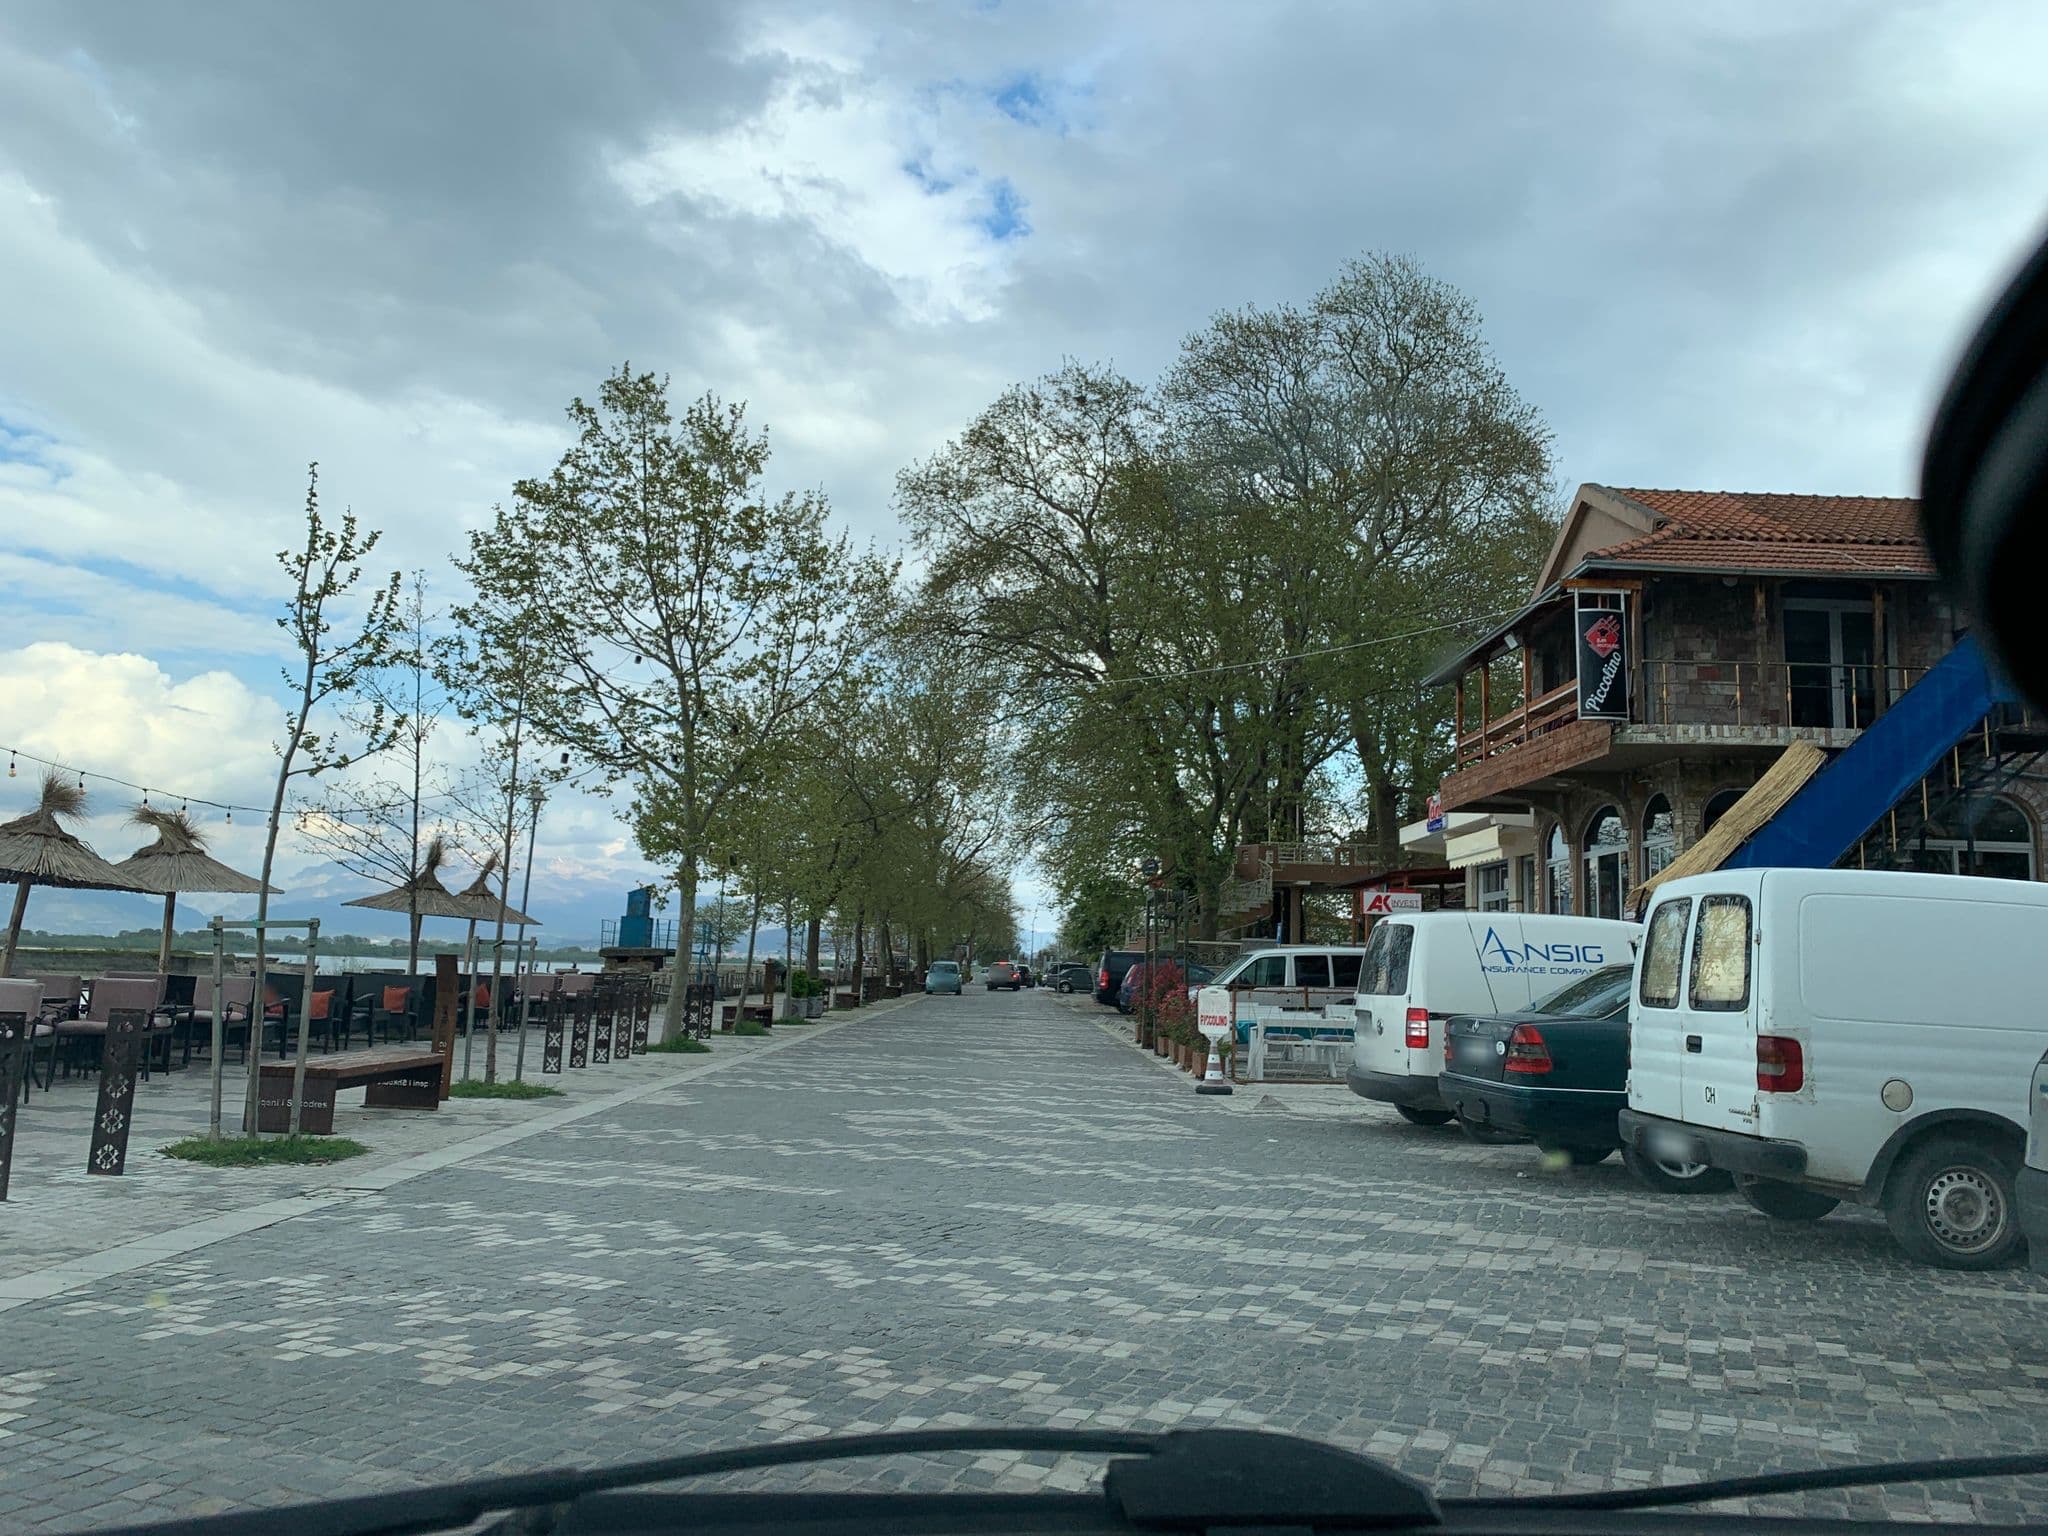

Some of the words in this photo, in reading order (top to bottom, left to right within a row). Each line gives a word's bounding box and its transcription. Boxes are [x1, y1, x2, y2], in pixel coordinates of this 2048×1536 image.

[1585, 651, 1622, 711] Piccolino
[1366, 894, 1393, 912] AK
[1481, 926, 1604, 965] ANSIG
[1481, 965, 1546, 974] INSURANCE
[1550, 967, 1593, 975] COMPA
[286, 1098, 328, 1109] Sodres
[1705, 1086, 1716, 1104] CH
